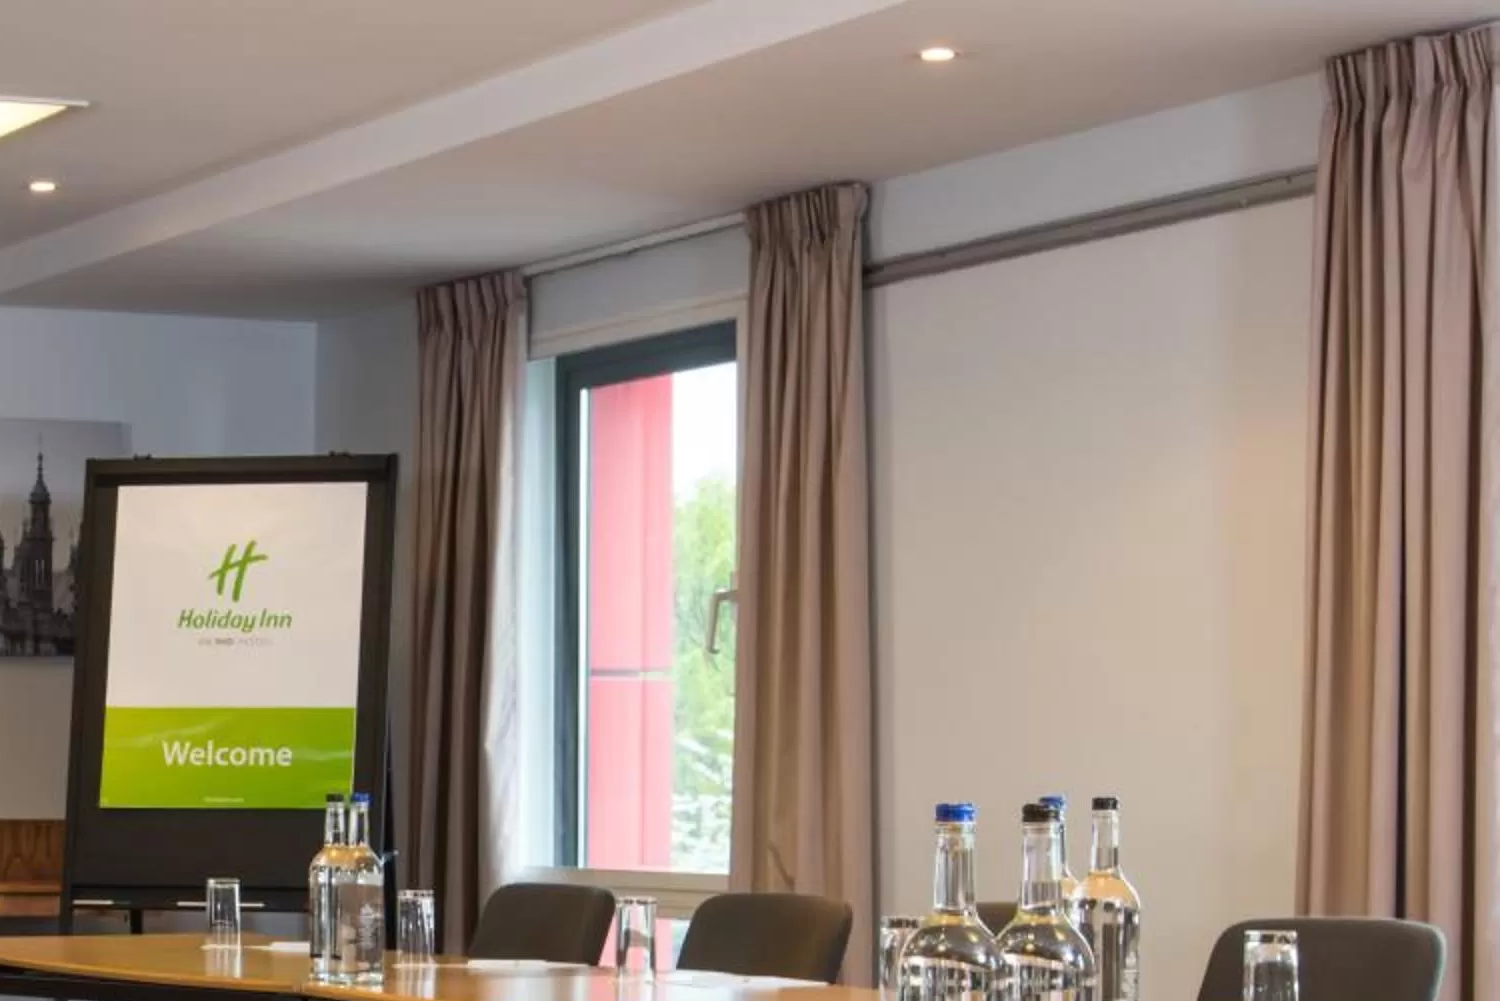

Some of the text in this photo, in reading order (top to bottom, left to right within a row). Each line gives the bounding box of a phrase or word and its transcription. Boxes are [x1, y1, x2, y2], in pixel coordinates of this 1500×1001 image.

[177, 608, 293, 633] Holiday Inn
[162, 740, 293, 767] Welcome
